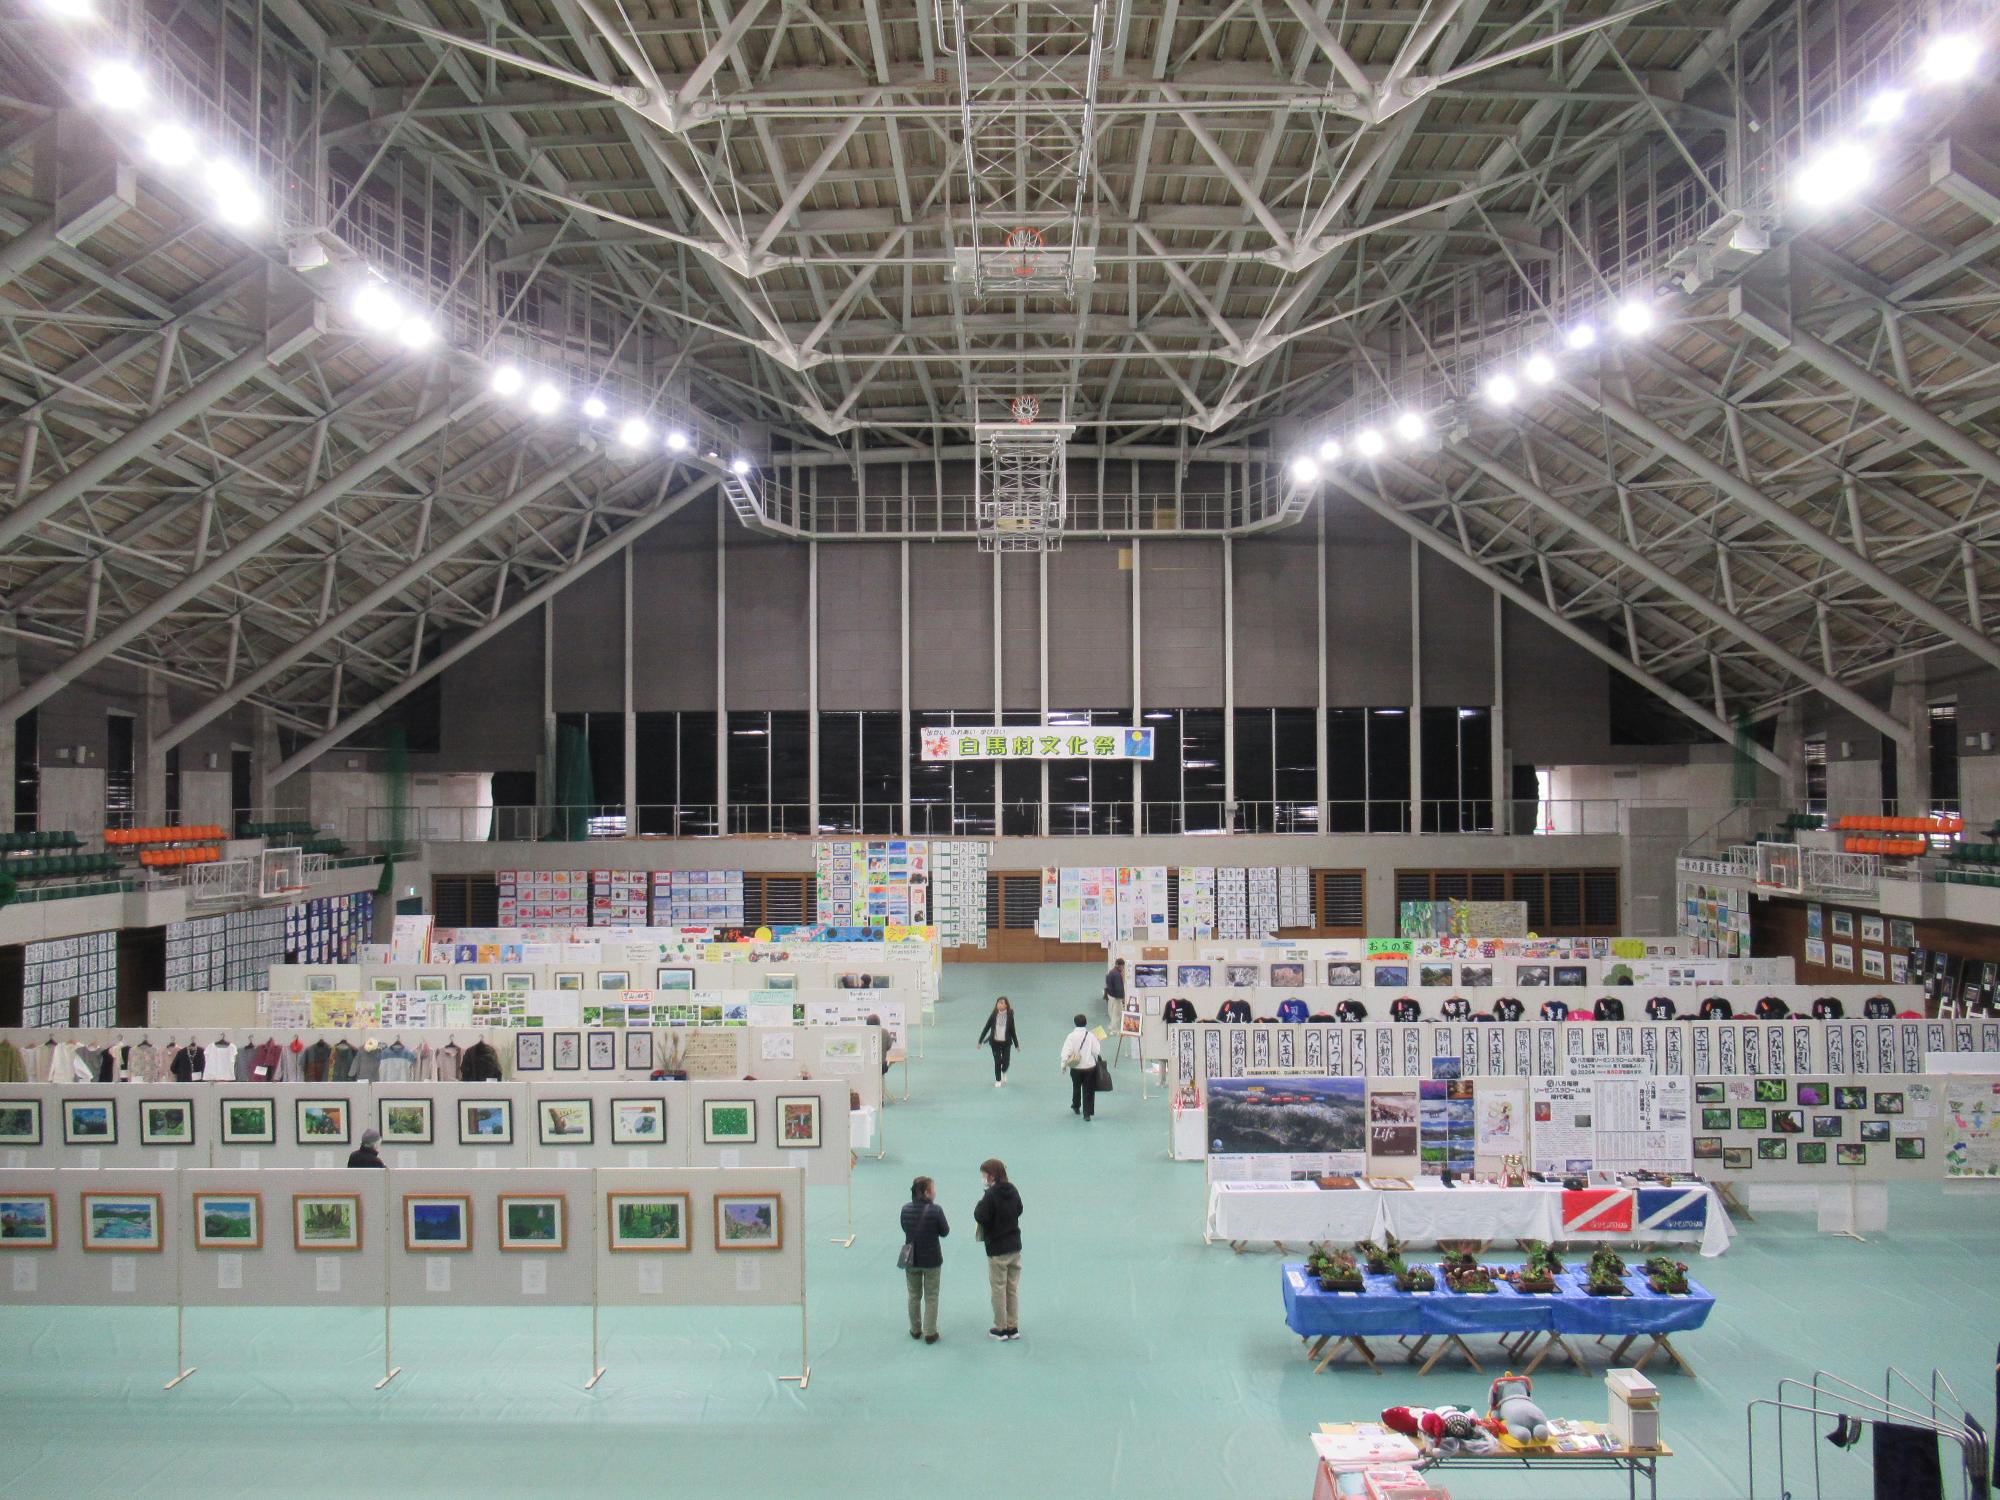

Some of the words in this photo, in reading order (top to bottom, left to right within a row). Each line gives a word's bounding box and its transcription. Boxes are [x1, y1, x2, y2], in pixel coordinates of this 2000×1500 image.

[958, 735, 1117, 756] 白馬村文化祭
[1369, 939, 1412, 951] おらの家
[1233, 1030, 1245, 1078] 感動の涙
[1379, 1030, 1391, 1077] 感動の涙
[1406, 1029, 1418, 1076] 感動の涙
[1465, 1030, 1476, 1076] 大玉送り
[1491, 1031, 1502, 1076] 大玉送り
[1518, 1030, 1529, 1077] 限界に挑戦
[1669, 1029, 1680, 1074] 大玉送り
[1721, 1029, 1733, 1075] つな引き
[1746, 1030, 1757, 1074] つな引き
[1770, 1029, 1782, 1075] つな引き
[1796, 1028, 1809, 1074] つな引き
[1373, 1127, 1396, 1142] Life
